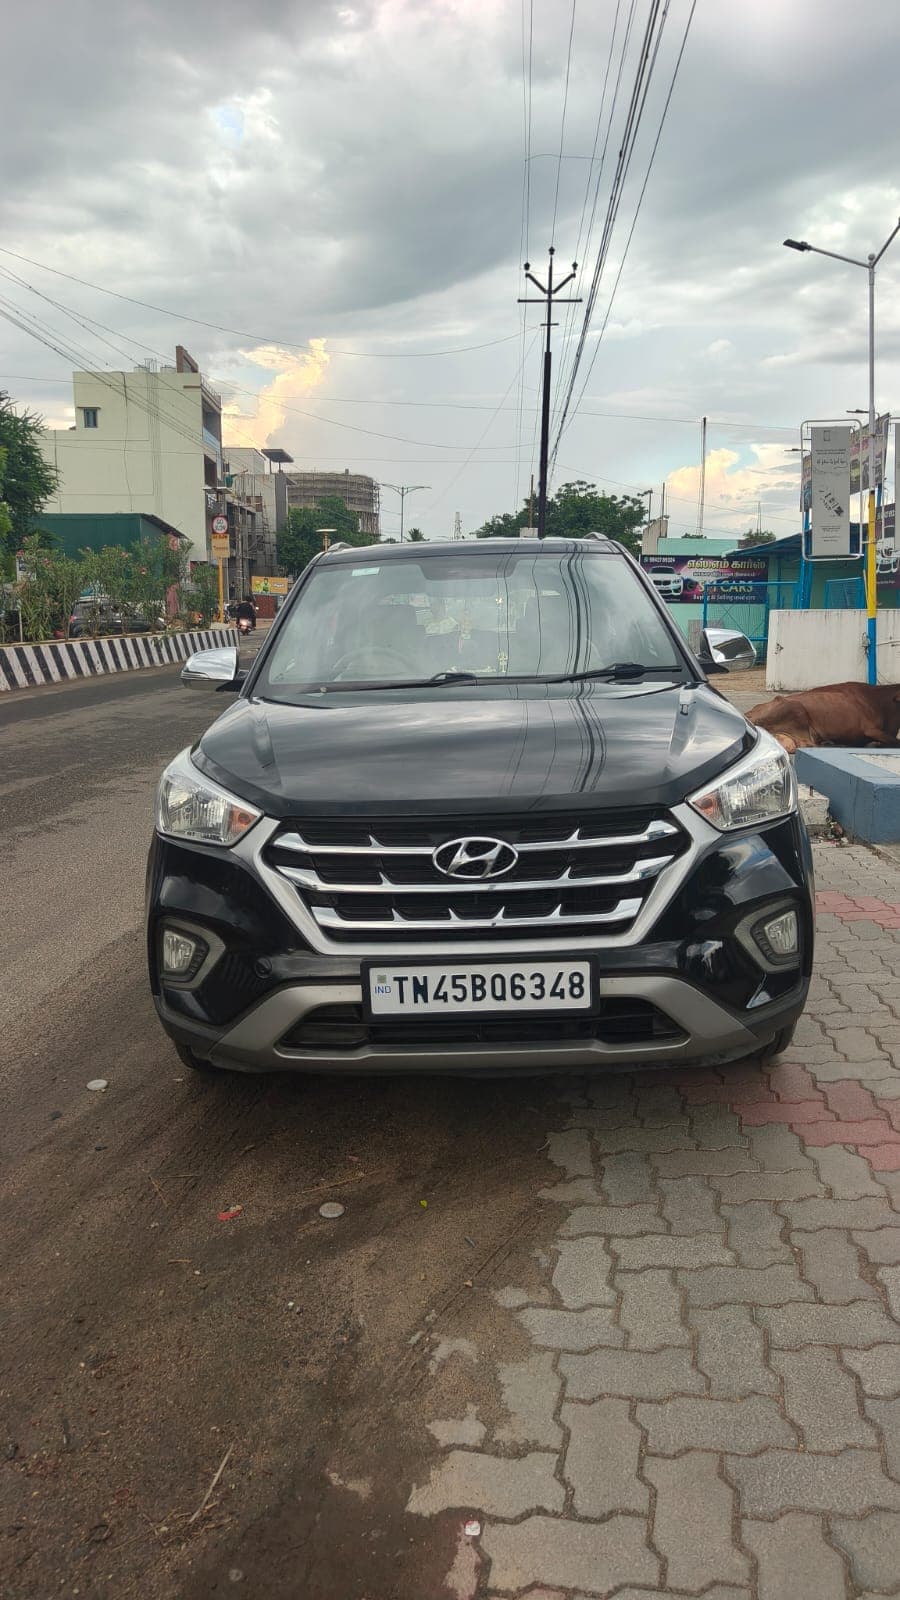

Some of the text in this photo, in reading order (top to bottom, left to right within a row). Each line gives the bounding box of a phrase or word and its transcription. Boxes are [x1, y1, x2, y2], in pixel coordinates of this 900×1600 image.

[721, 580, 753, 592] CARS
[374, 985, 392, 995] IND
[393, 971, 585, 1004] TN45BQ6348
